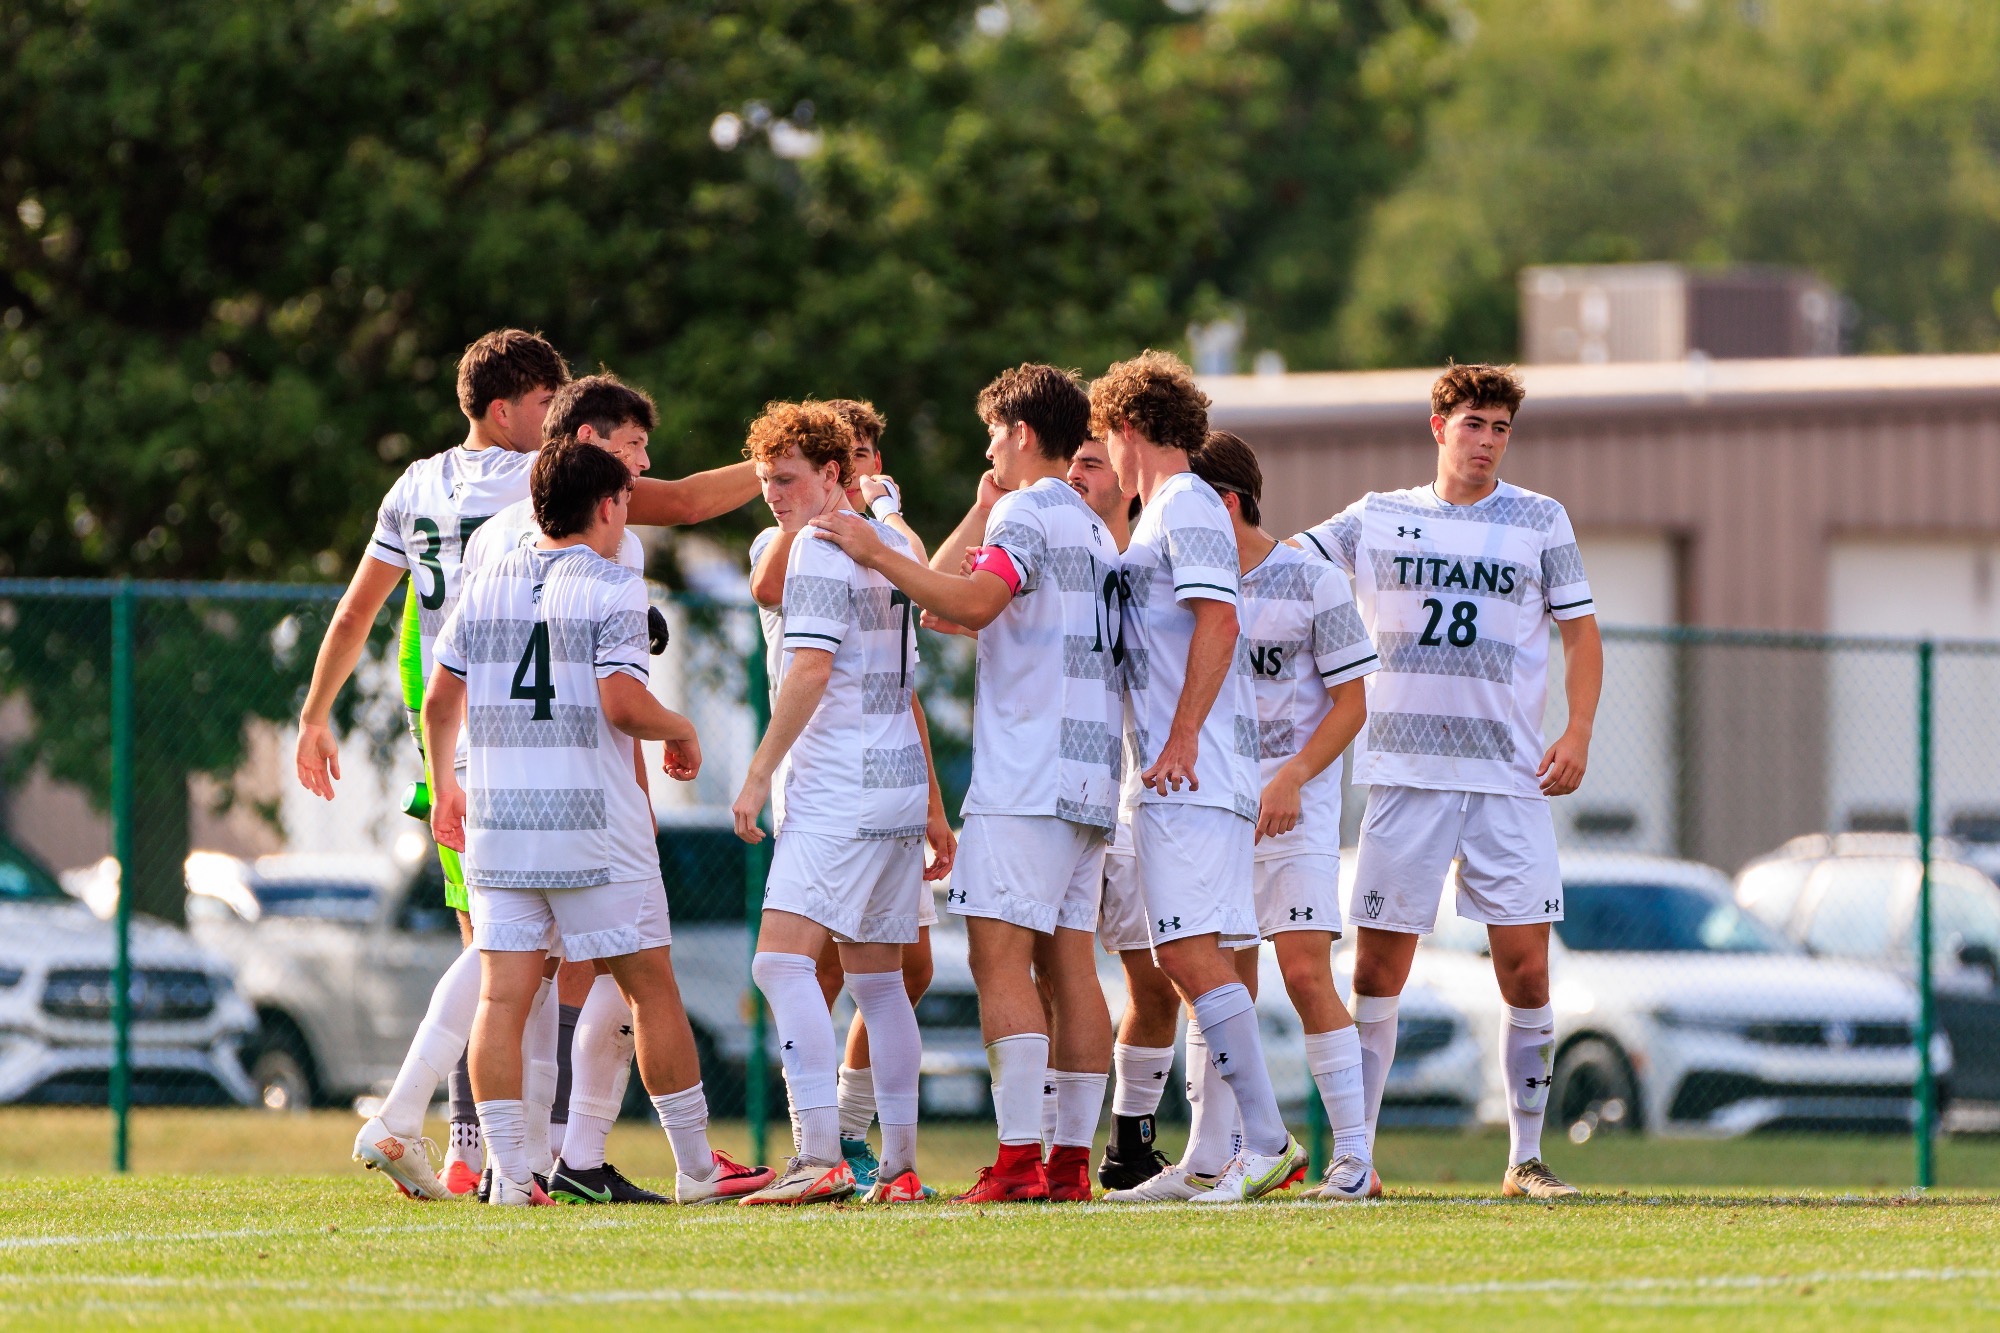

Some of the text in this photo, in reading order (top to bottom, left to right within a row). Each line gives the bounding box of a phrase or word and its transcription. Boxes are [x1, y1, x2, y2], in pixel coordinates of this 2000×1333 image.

[1087, 552, 1124, 667] 10
[1393, 556, 1516, 594] TITANS
[1418, 598, 1478, 647] 28
[510, 621, 556, 720] 4
